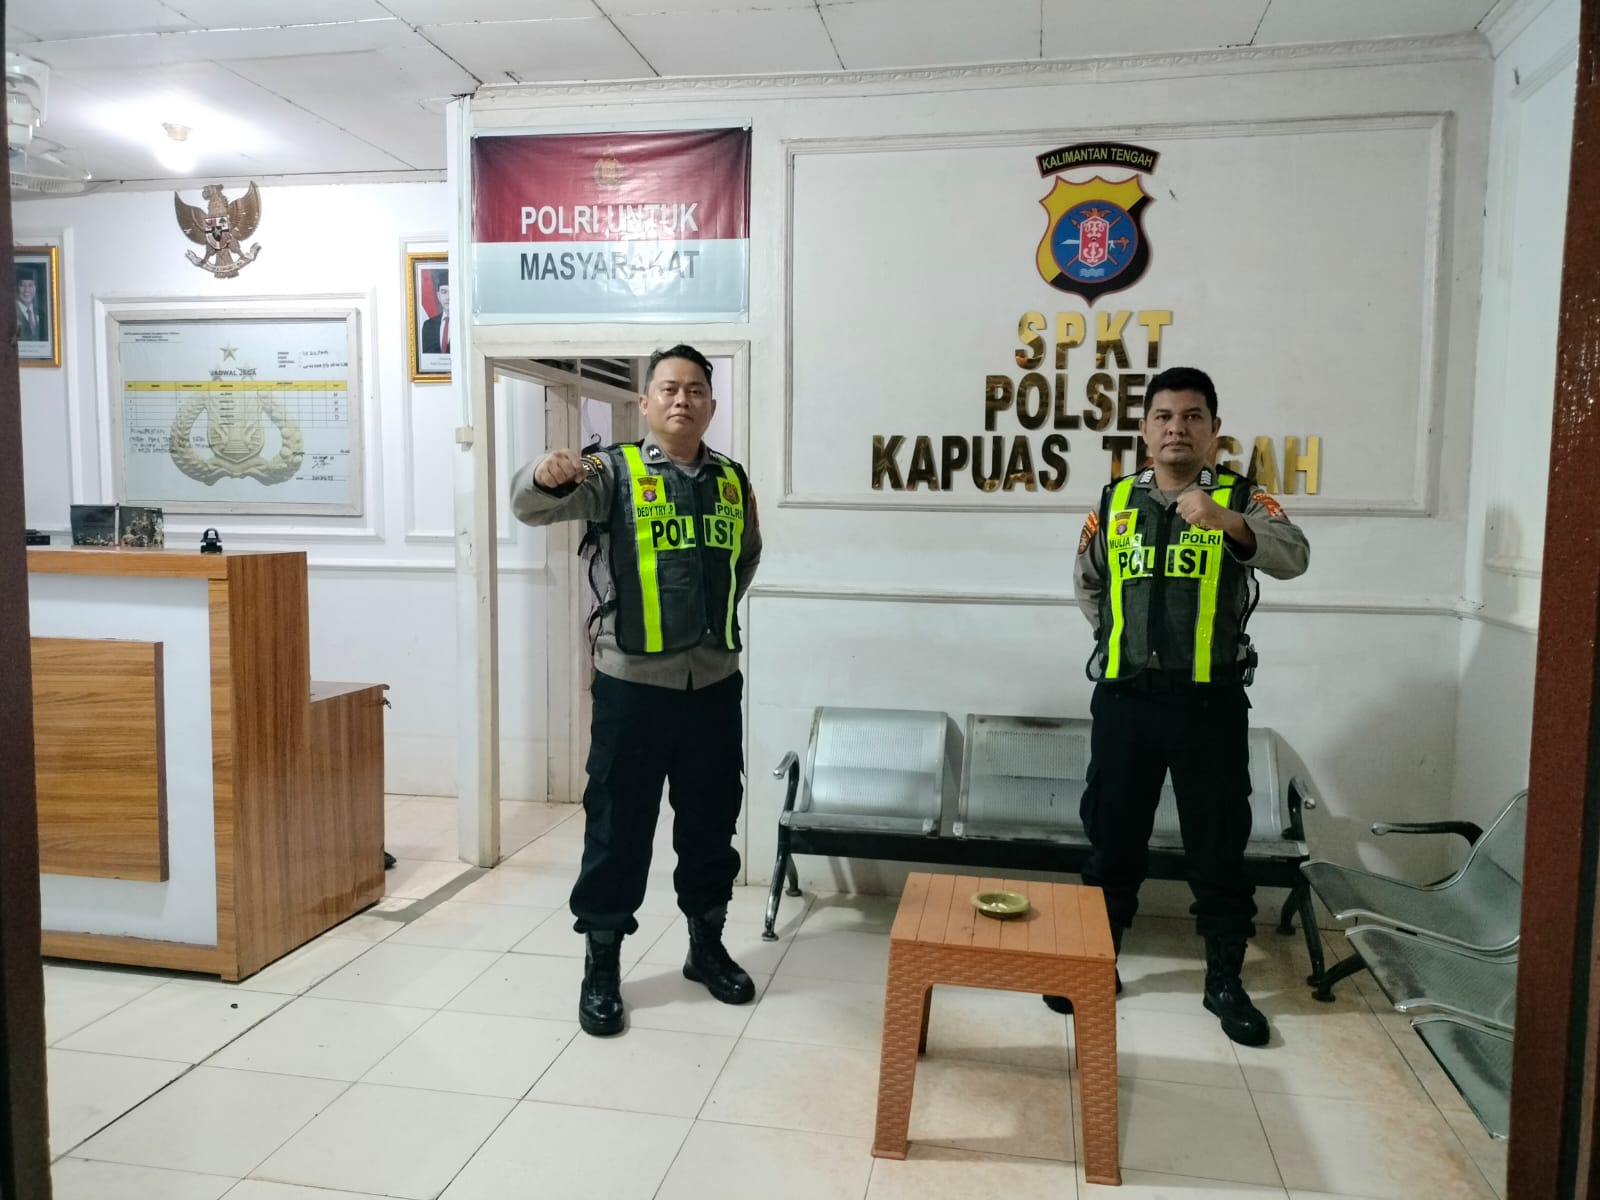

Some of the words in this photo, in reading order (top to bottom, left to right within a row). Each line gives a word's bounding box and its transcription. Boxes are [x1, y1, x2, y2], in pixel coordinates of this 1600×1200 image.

[1042, 148, 1108, 171] KALIMANTAN
[1111, 148, 1153, 168] TENGAH
[521, 205, 600, 235] POLRI
[607, 203, 698, 233] UNTUK
[520, 250, 699, 281] MASYARAKAT
[1014, 310, 1173, 370] SPKT
[984, 372, 1151, 432] POLSE
[871, 434, 1070, 492] KAPUAS
[636, 506, 653, 518] DEDY
[716, 504, 743, 519] POLRI
[1181, 533, 1221, 545] POLRI
